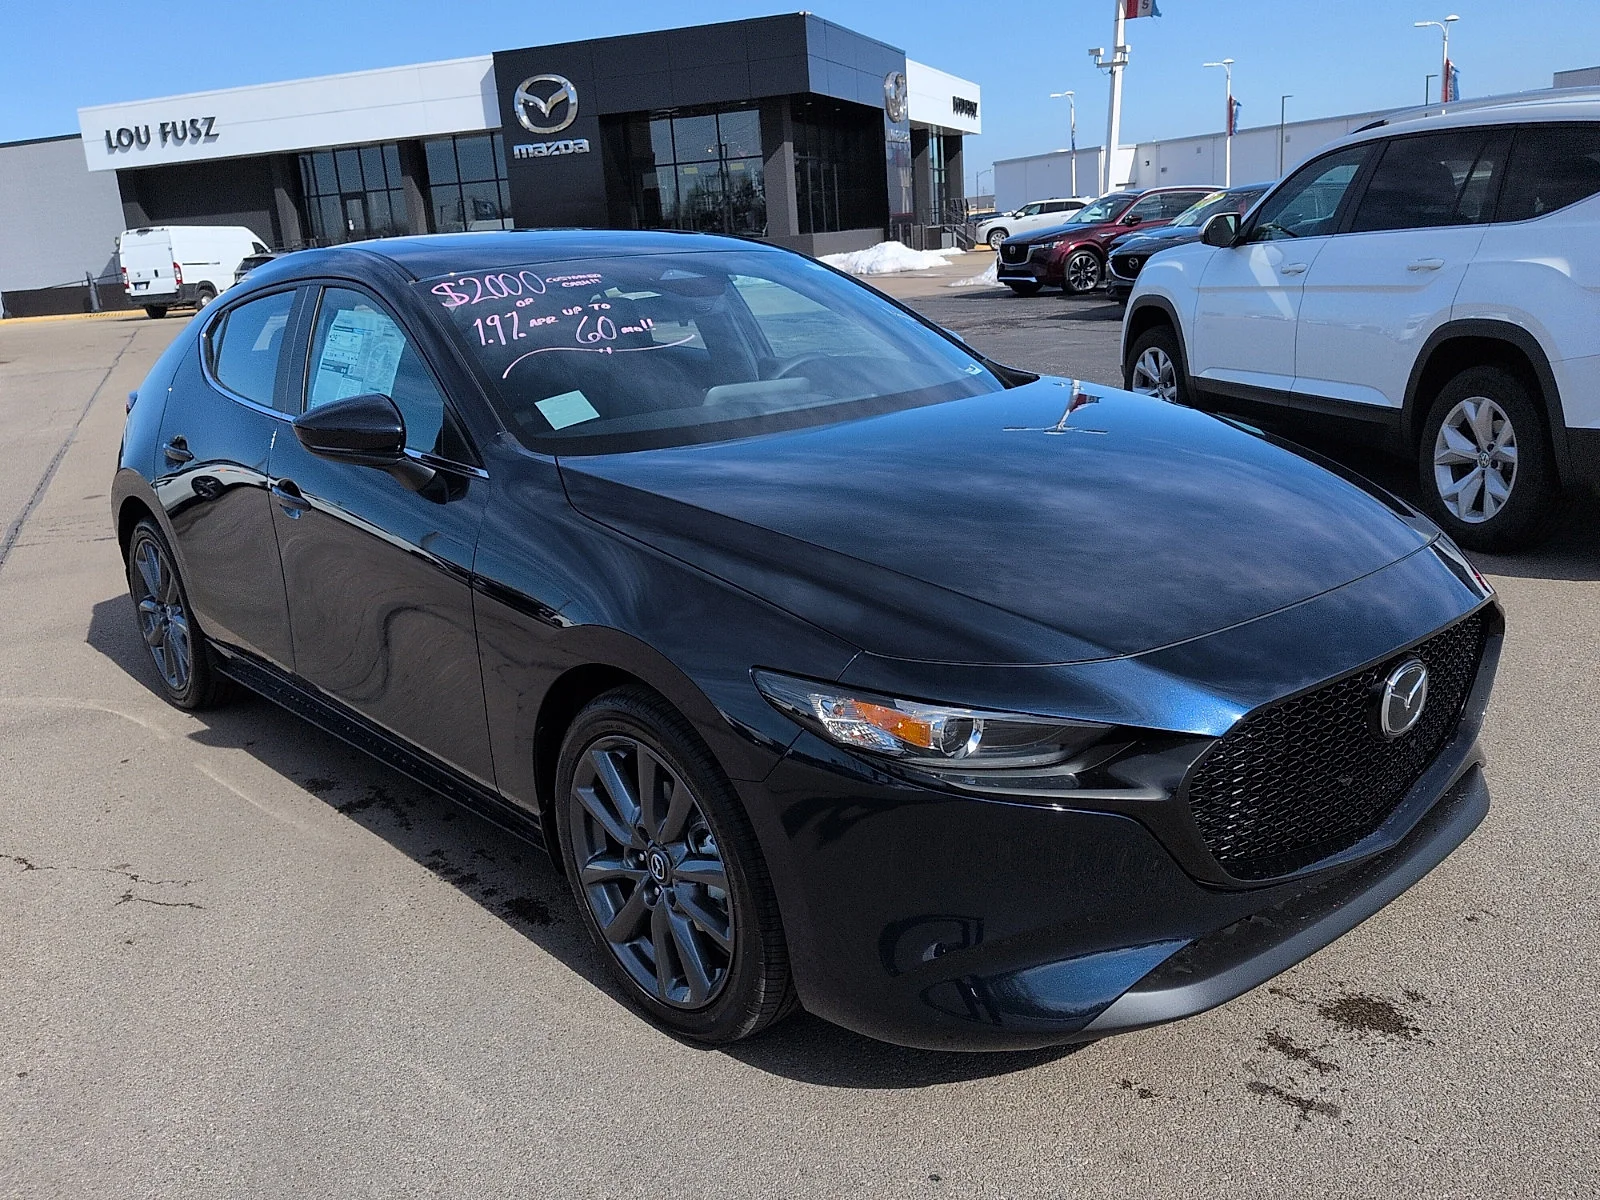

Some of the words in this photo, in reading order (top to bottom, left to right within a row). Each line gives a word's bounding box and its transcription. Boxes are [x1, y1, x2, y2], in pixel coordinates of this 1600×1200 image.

[105, 125, 151, 149] LOU
[159, 116, 219, 143] FUSZ
[431, 270, 546, 307] $2000
[516, 297, 534, 307] OR
[529, 316, 558, 327] APR
[562, 306, 582, 315] UP
[576, 315, 617, 343] 60
